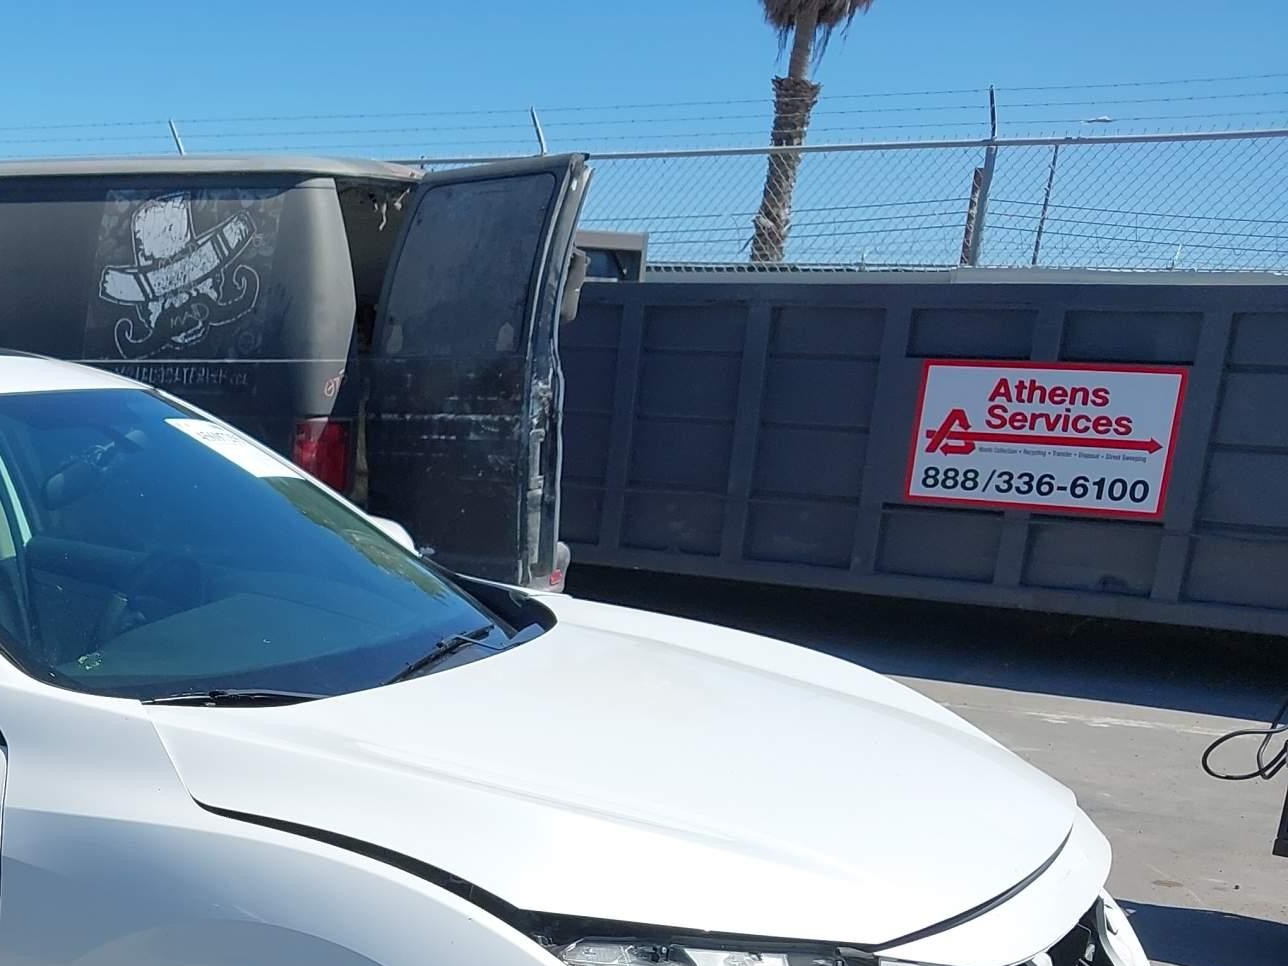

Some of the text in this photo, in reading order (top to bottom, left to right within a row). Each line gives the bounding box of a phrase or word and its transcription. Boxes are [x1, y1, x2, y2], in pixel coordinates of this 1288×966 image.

[988, 378, 1110, 407] Athens
[985, 404, 1132, 436] Services
[921, 467, 1150, 503] 888/336-6100
